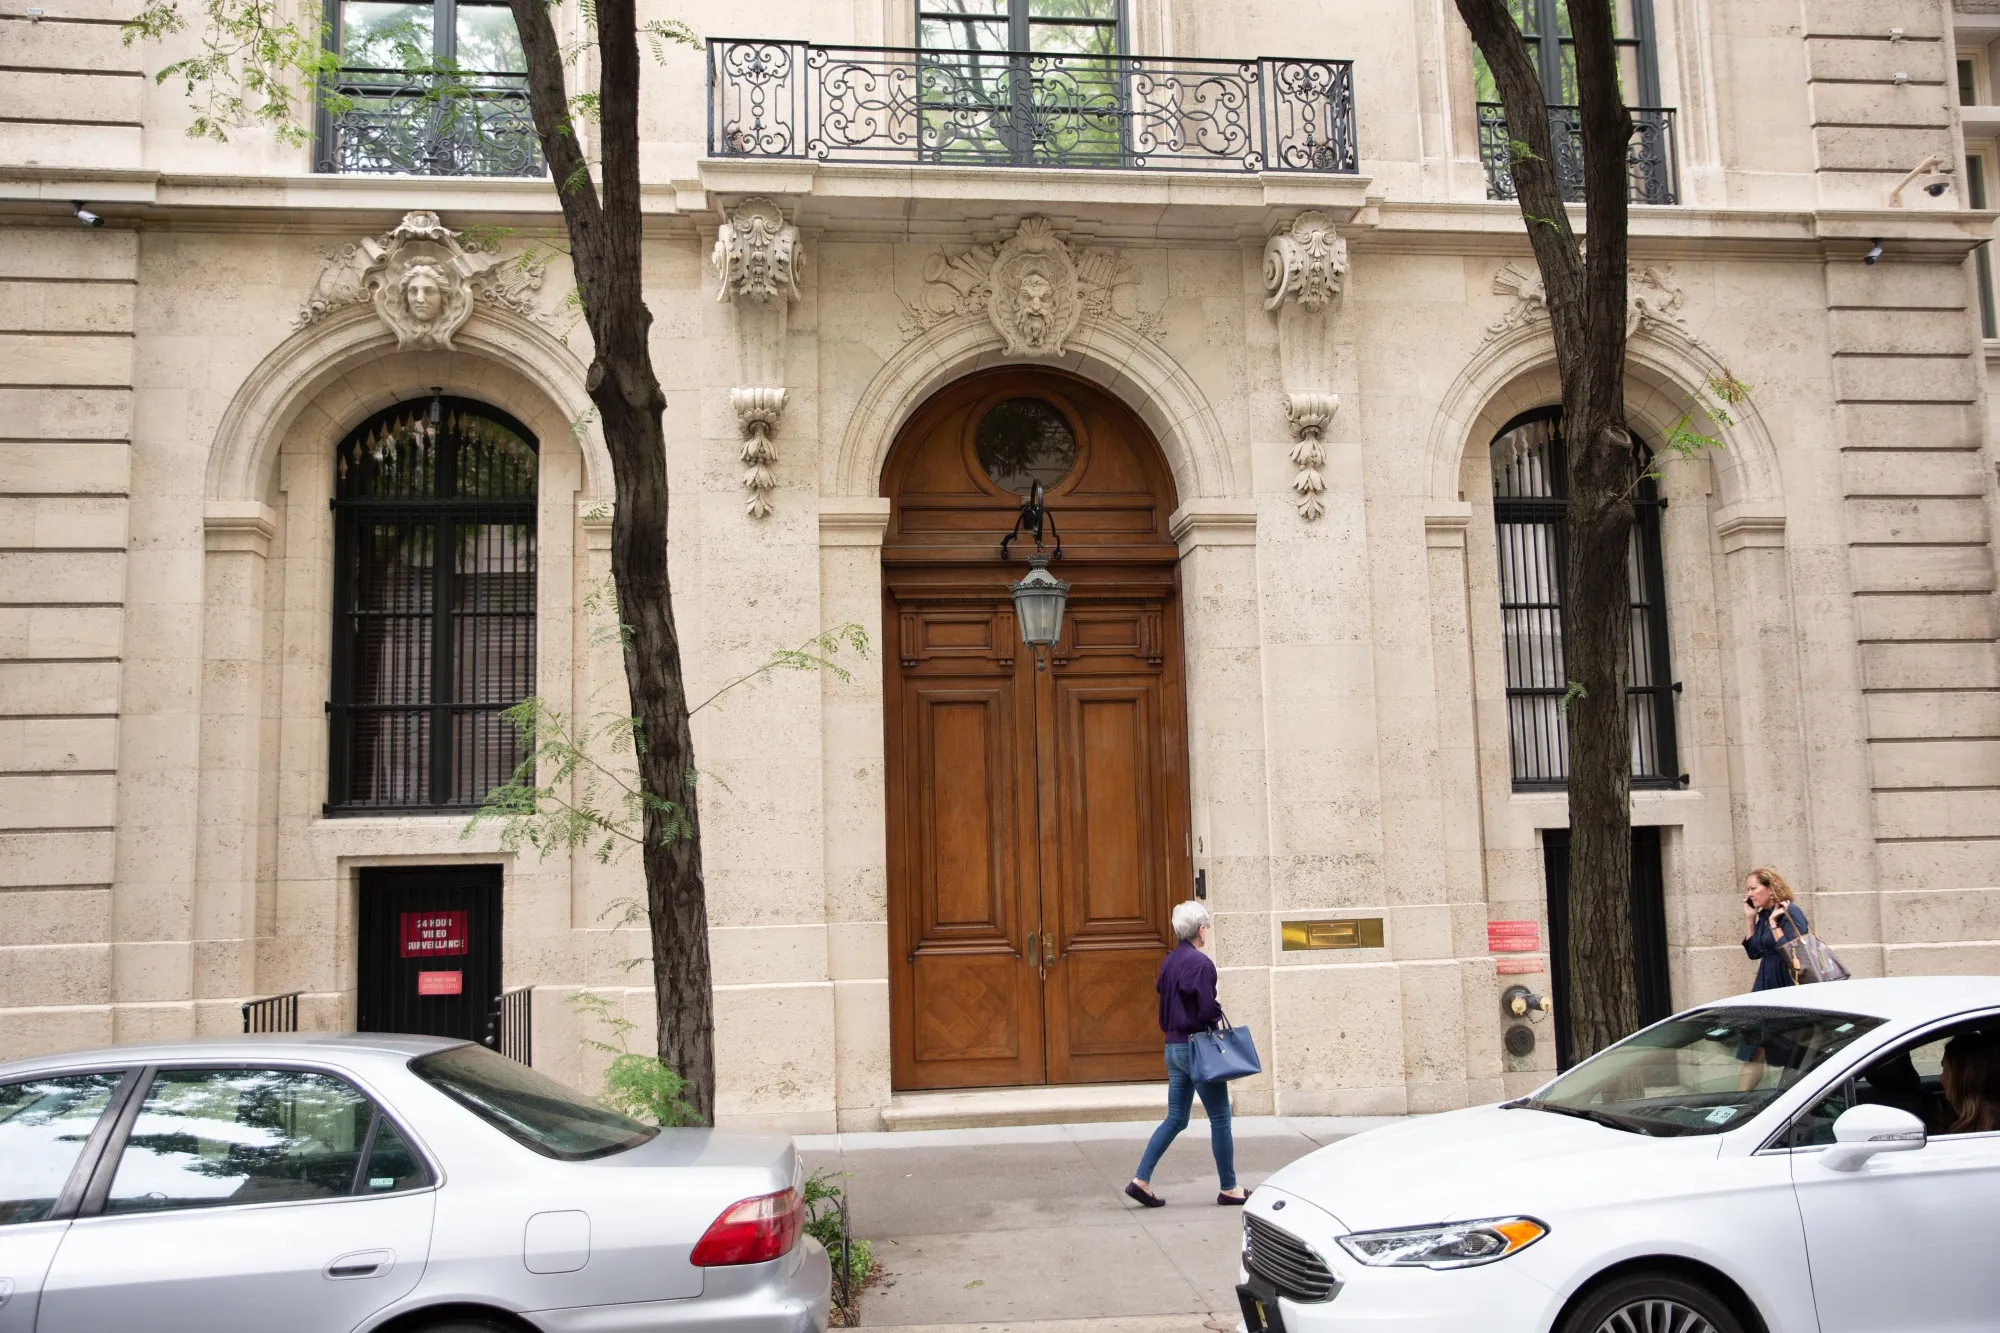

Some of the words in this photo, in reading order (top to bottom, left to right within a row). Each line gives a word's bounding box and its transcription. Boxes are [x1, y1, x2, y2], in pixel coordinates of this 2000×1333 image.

[416, 919, 428, 928] 24
[429, 918, 452, 927] HOUR
[422, 929, 447, 939] VIDEO
[408, 939, 465, 951] SURVEILLANCE
